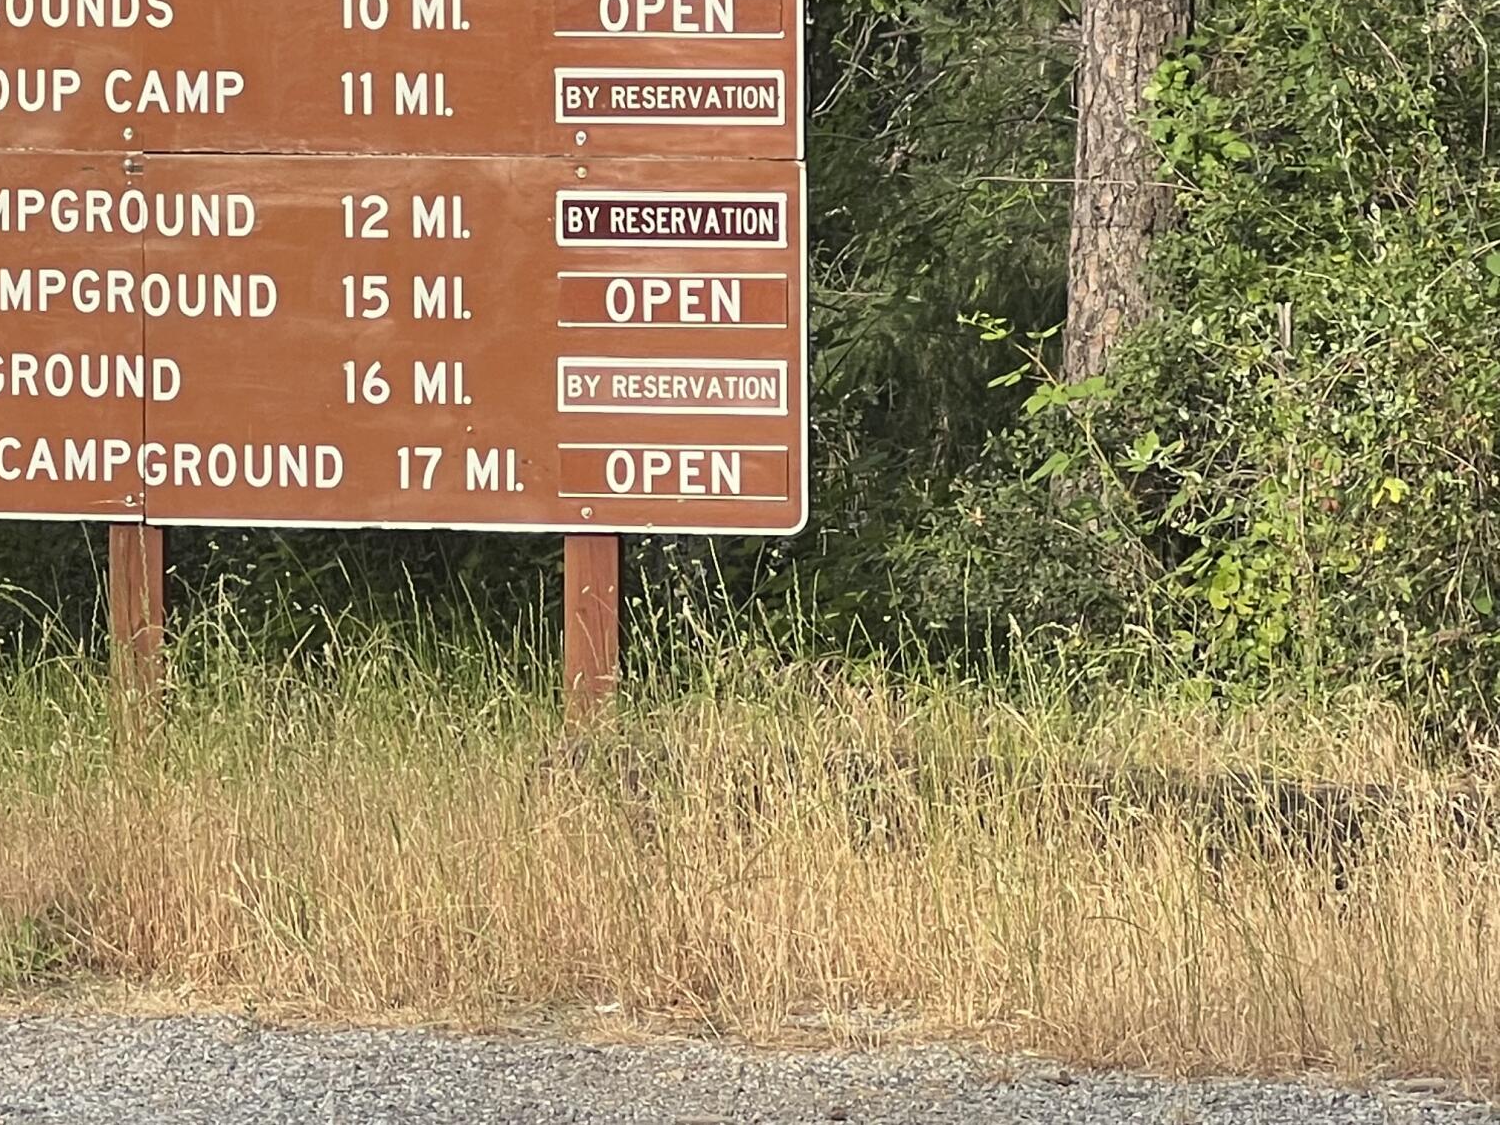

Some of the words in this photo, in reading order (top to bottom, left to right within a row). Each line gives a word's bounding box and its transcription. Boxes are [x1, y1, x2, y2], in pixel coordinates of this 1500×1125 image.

[105, 70, 244, 113] CAMP
[341, 72, 372, 115] 11
[396, 72, 453, 116] MI.
[566, 86, 599, 109] BY
[611, 86, 774, 109] RESERVATION
[341, 195, 388, 238] 12
[413, 195, 470, 239] MI.
[568, 206, 599, 233] BY
[610, 207, 773, 235] RESERVATION
[342, 276, 389, 319] 15
[414, 276, 471, 319] MI.
[606, 279, 740, 322] OPEN
[344, 361, 390, 404] 16
[414, 361, 471, 404] MI.
[568, 375, 601, 398] BY
[612, 375, 776, 403] RESERVATION
[398, 447, 442, 489] 17
[467, 448, 524, 491] MI.
[606, 450, 740, 494] OPEN
